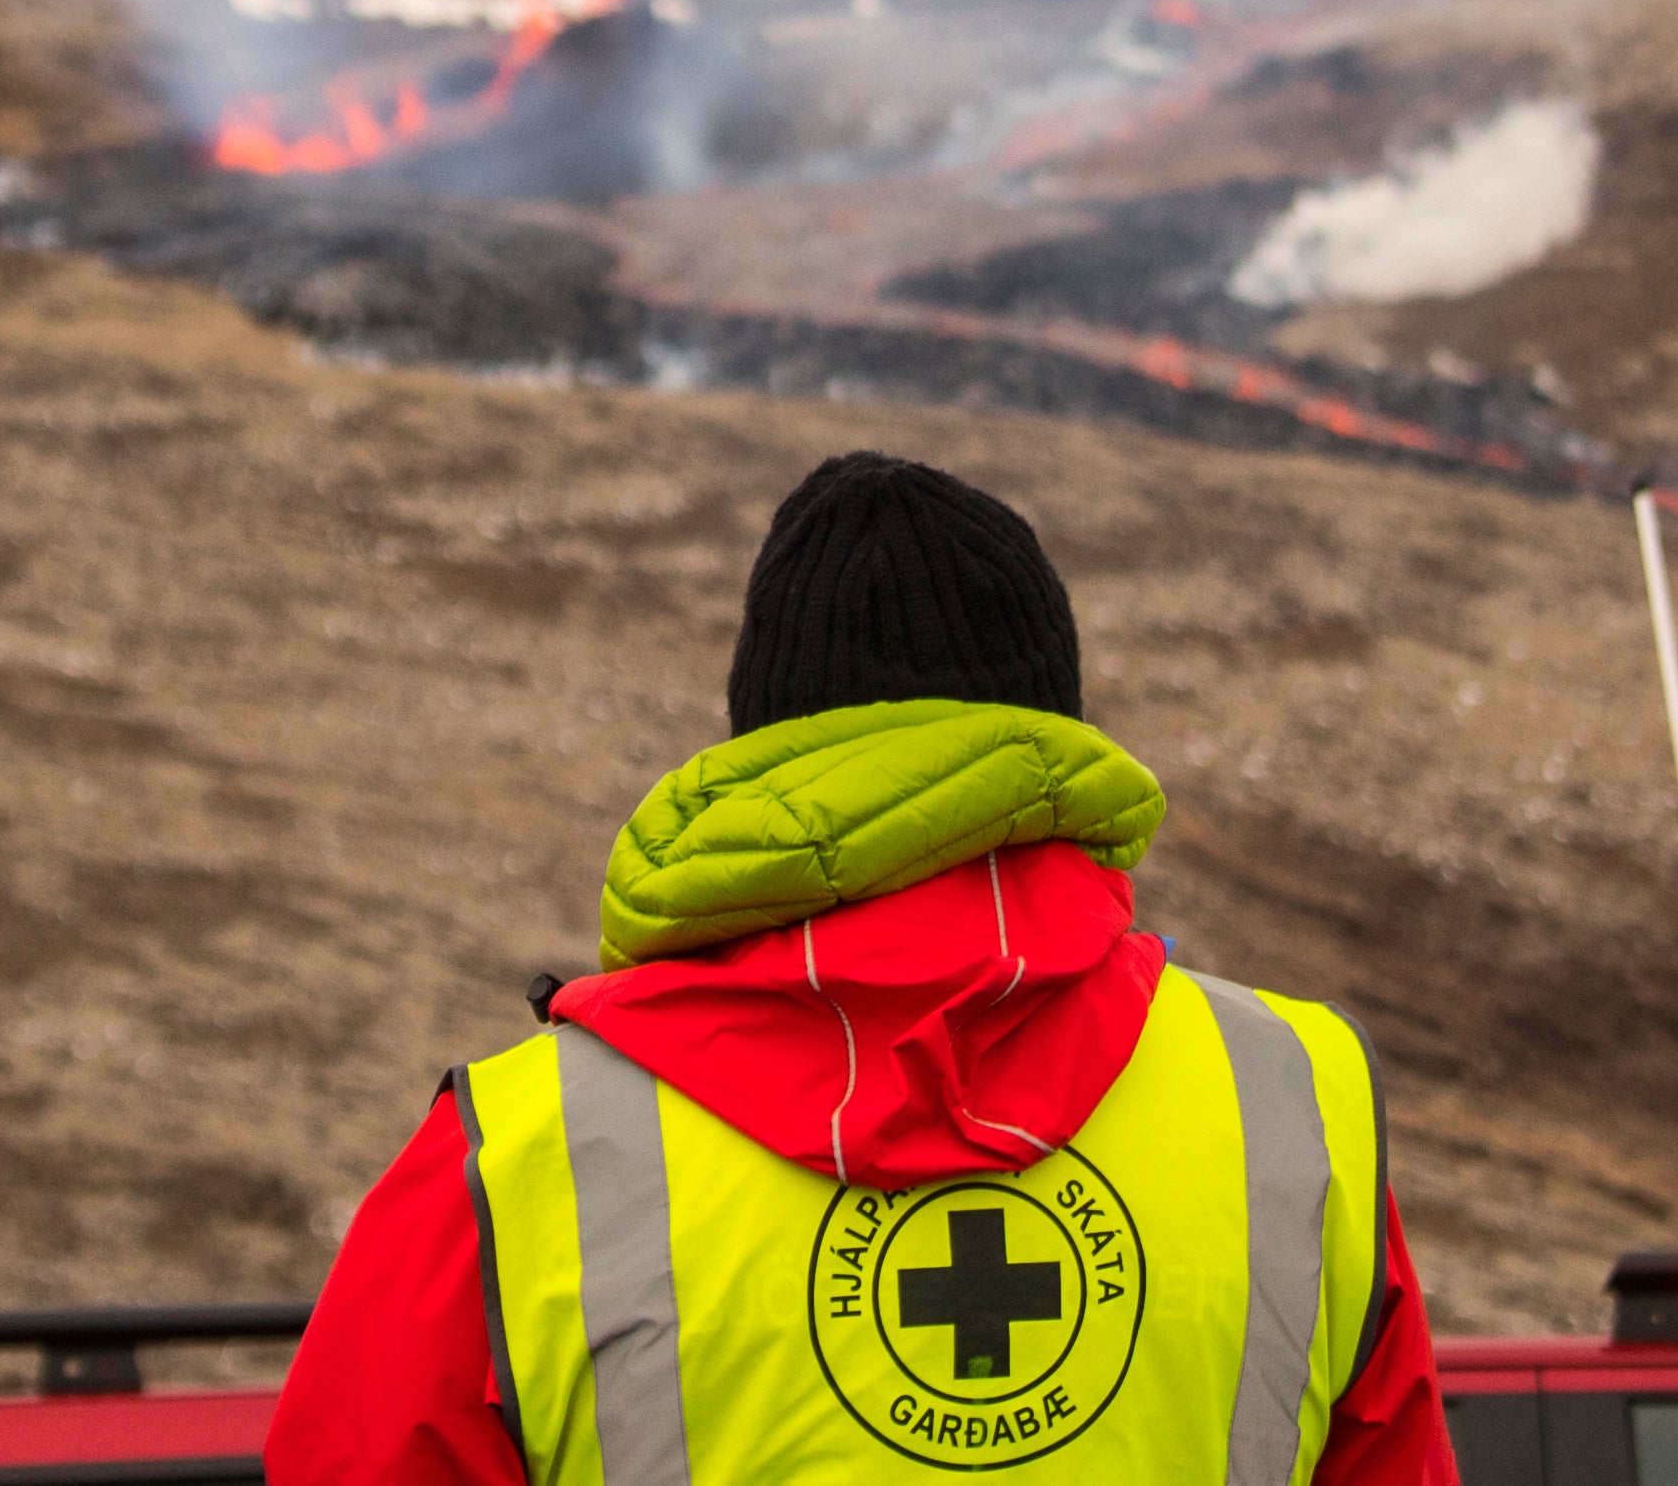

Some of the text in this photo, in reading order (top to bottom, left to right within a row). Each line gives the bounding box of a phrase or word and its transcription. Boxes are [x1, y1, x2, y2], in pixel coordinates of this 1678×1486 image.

[830, 1186, 917, 1318] HJÁLPA
[1056, 1179, 1125, 1305] SKÁTA
[889, 1384, 1077, 1449] GARÐABÆ
